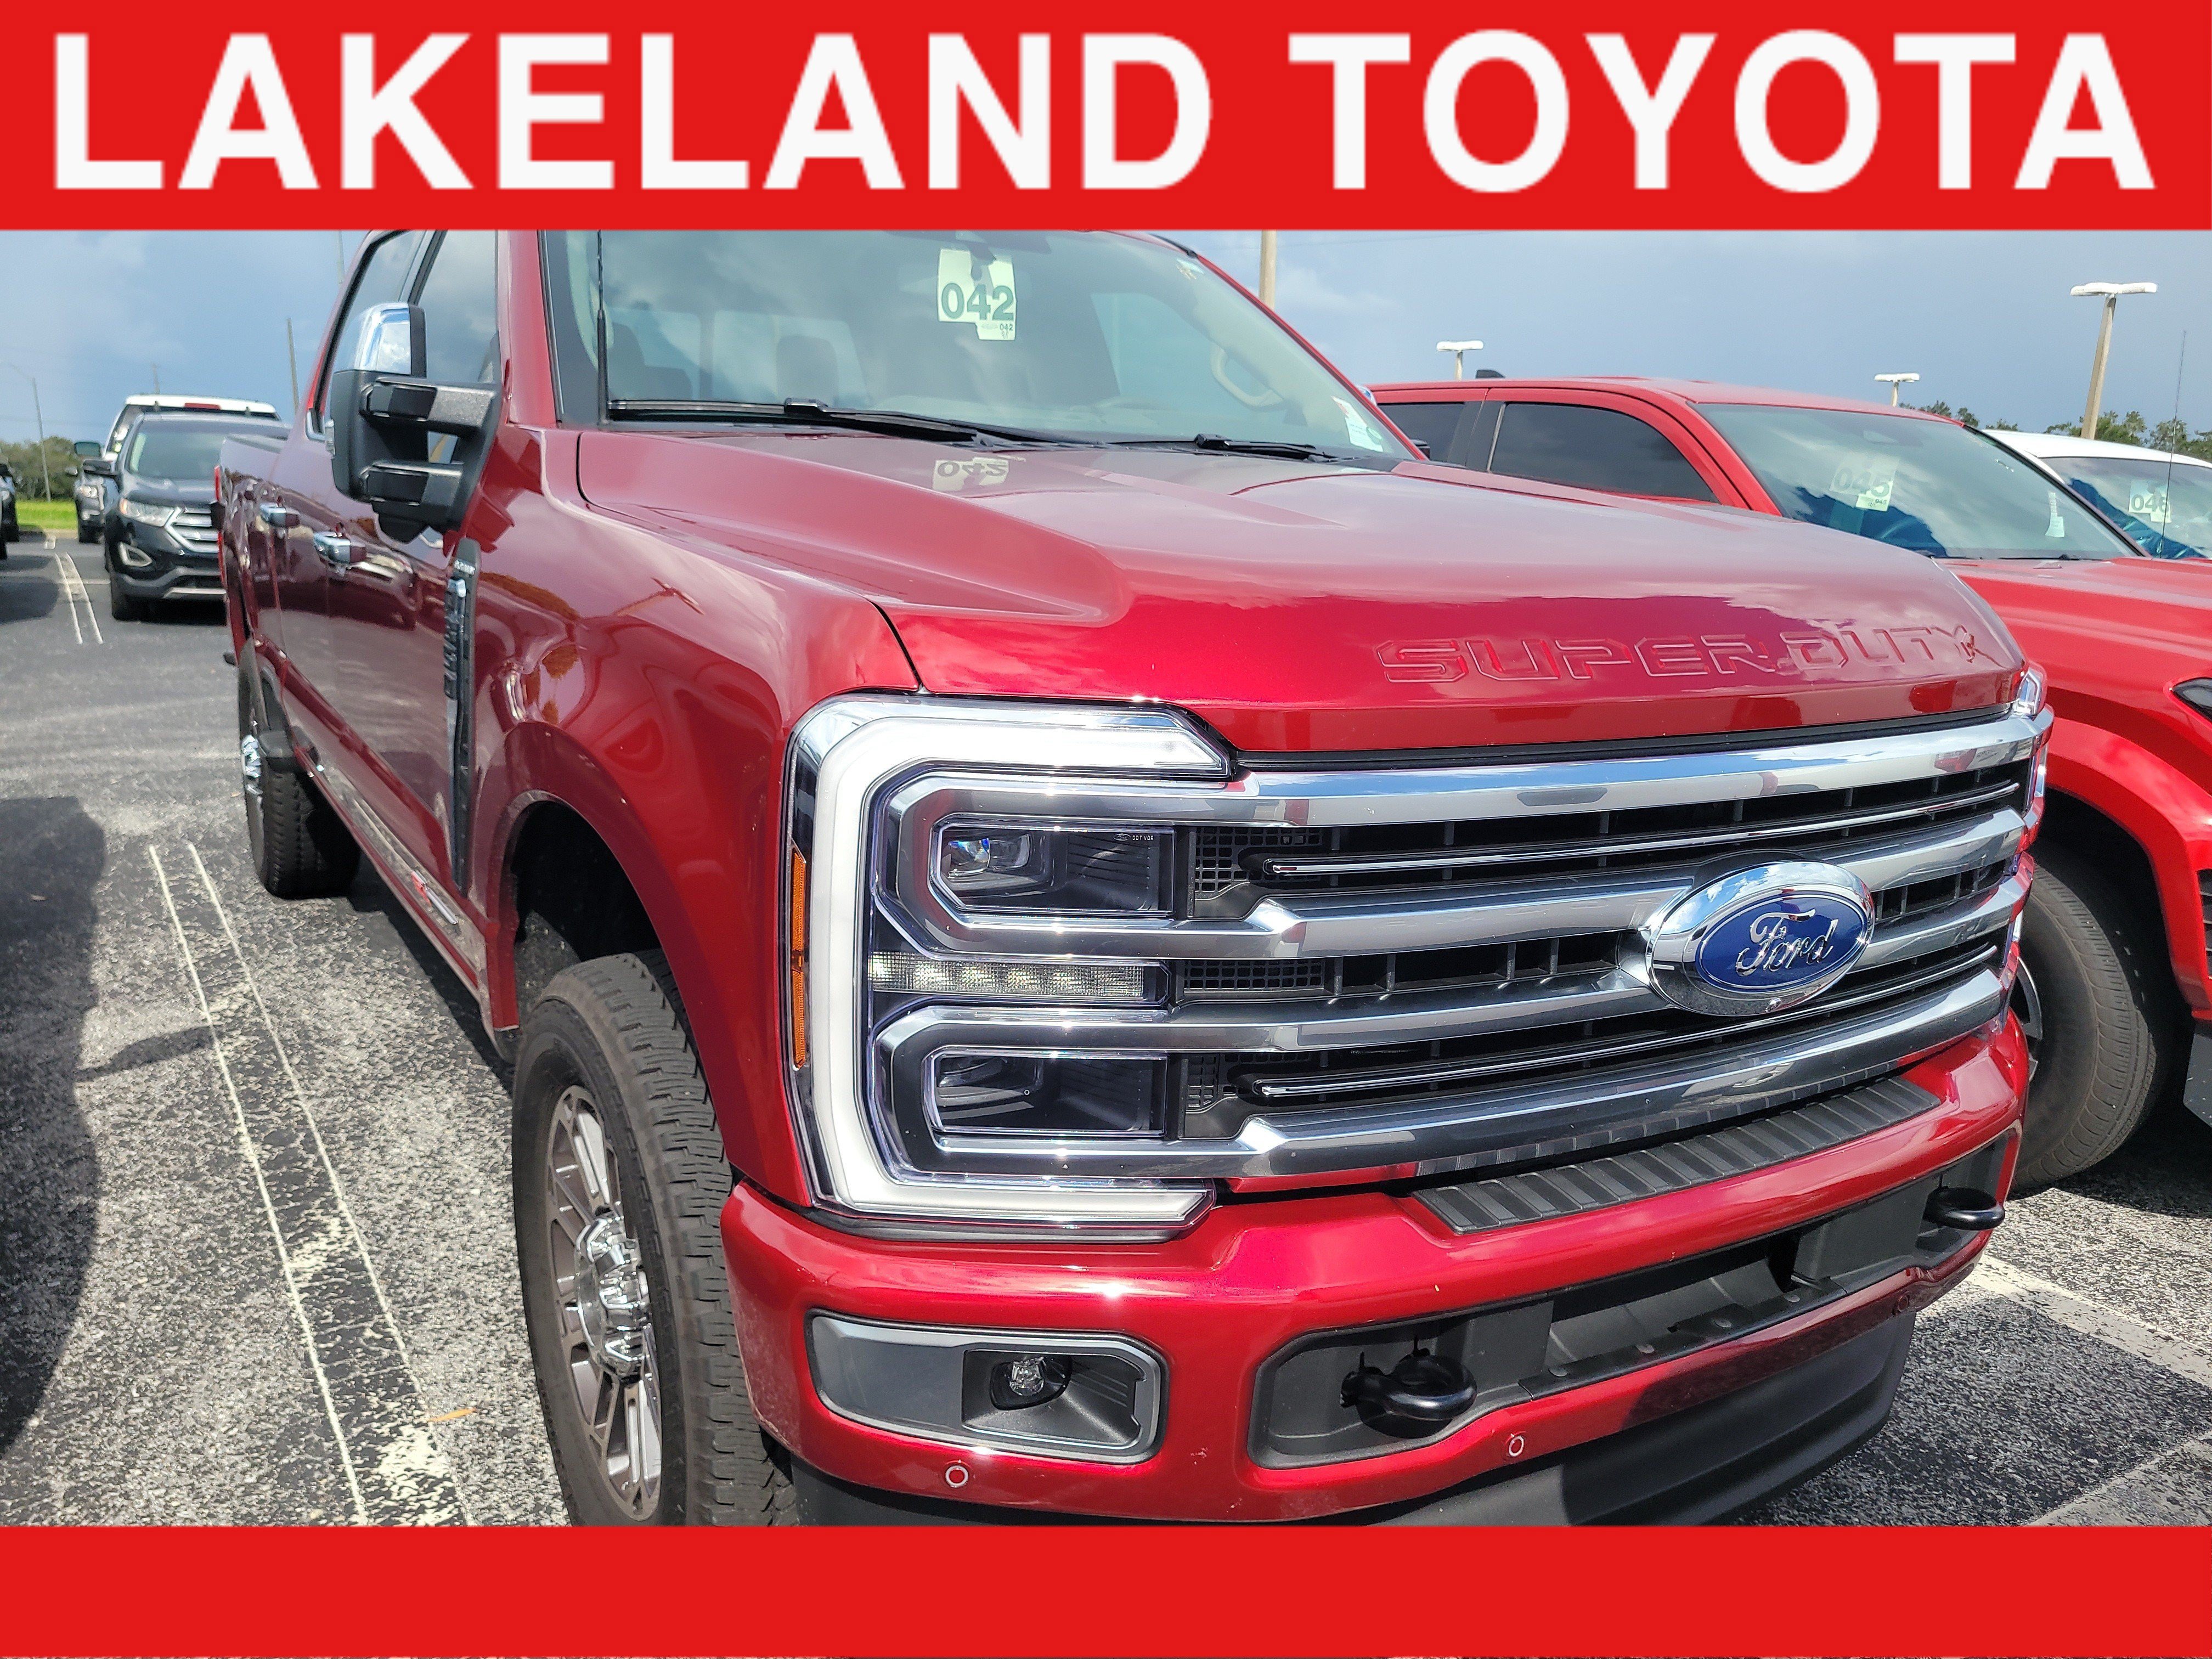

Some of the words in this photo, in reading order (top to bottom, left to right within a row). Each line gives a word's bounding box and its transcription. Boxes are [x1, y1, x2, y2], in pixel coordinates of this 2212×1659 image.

[941, 283, 1014, 320] 042
[1000, 323, 1013, 331] 042
[1833, 468, 1890, 498] 045
[2131, 494, 2169, 513] 046
[1374, 633, 1776, 684] SUPER
[1779, 624, 1978, 670] DUTY
[1736, 909, 1839, 977] Ford
